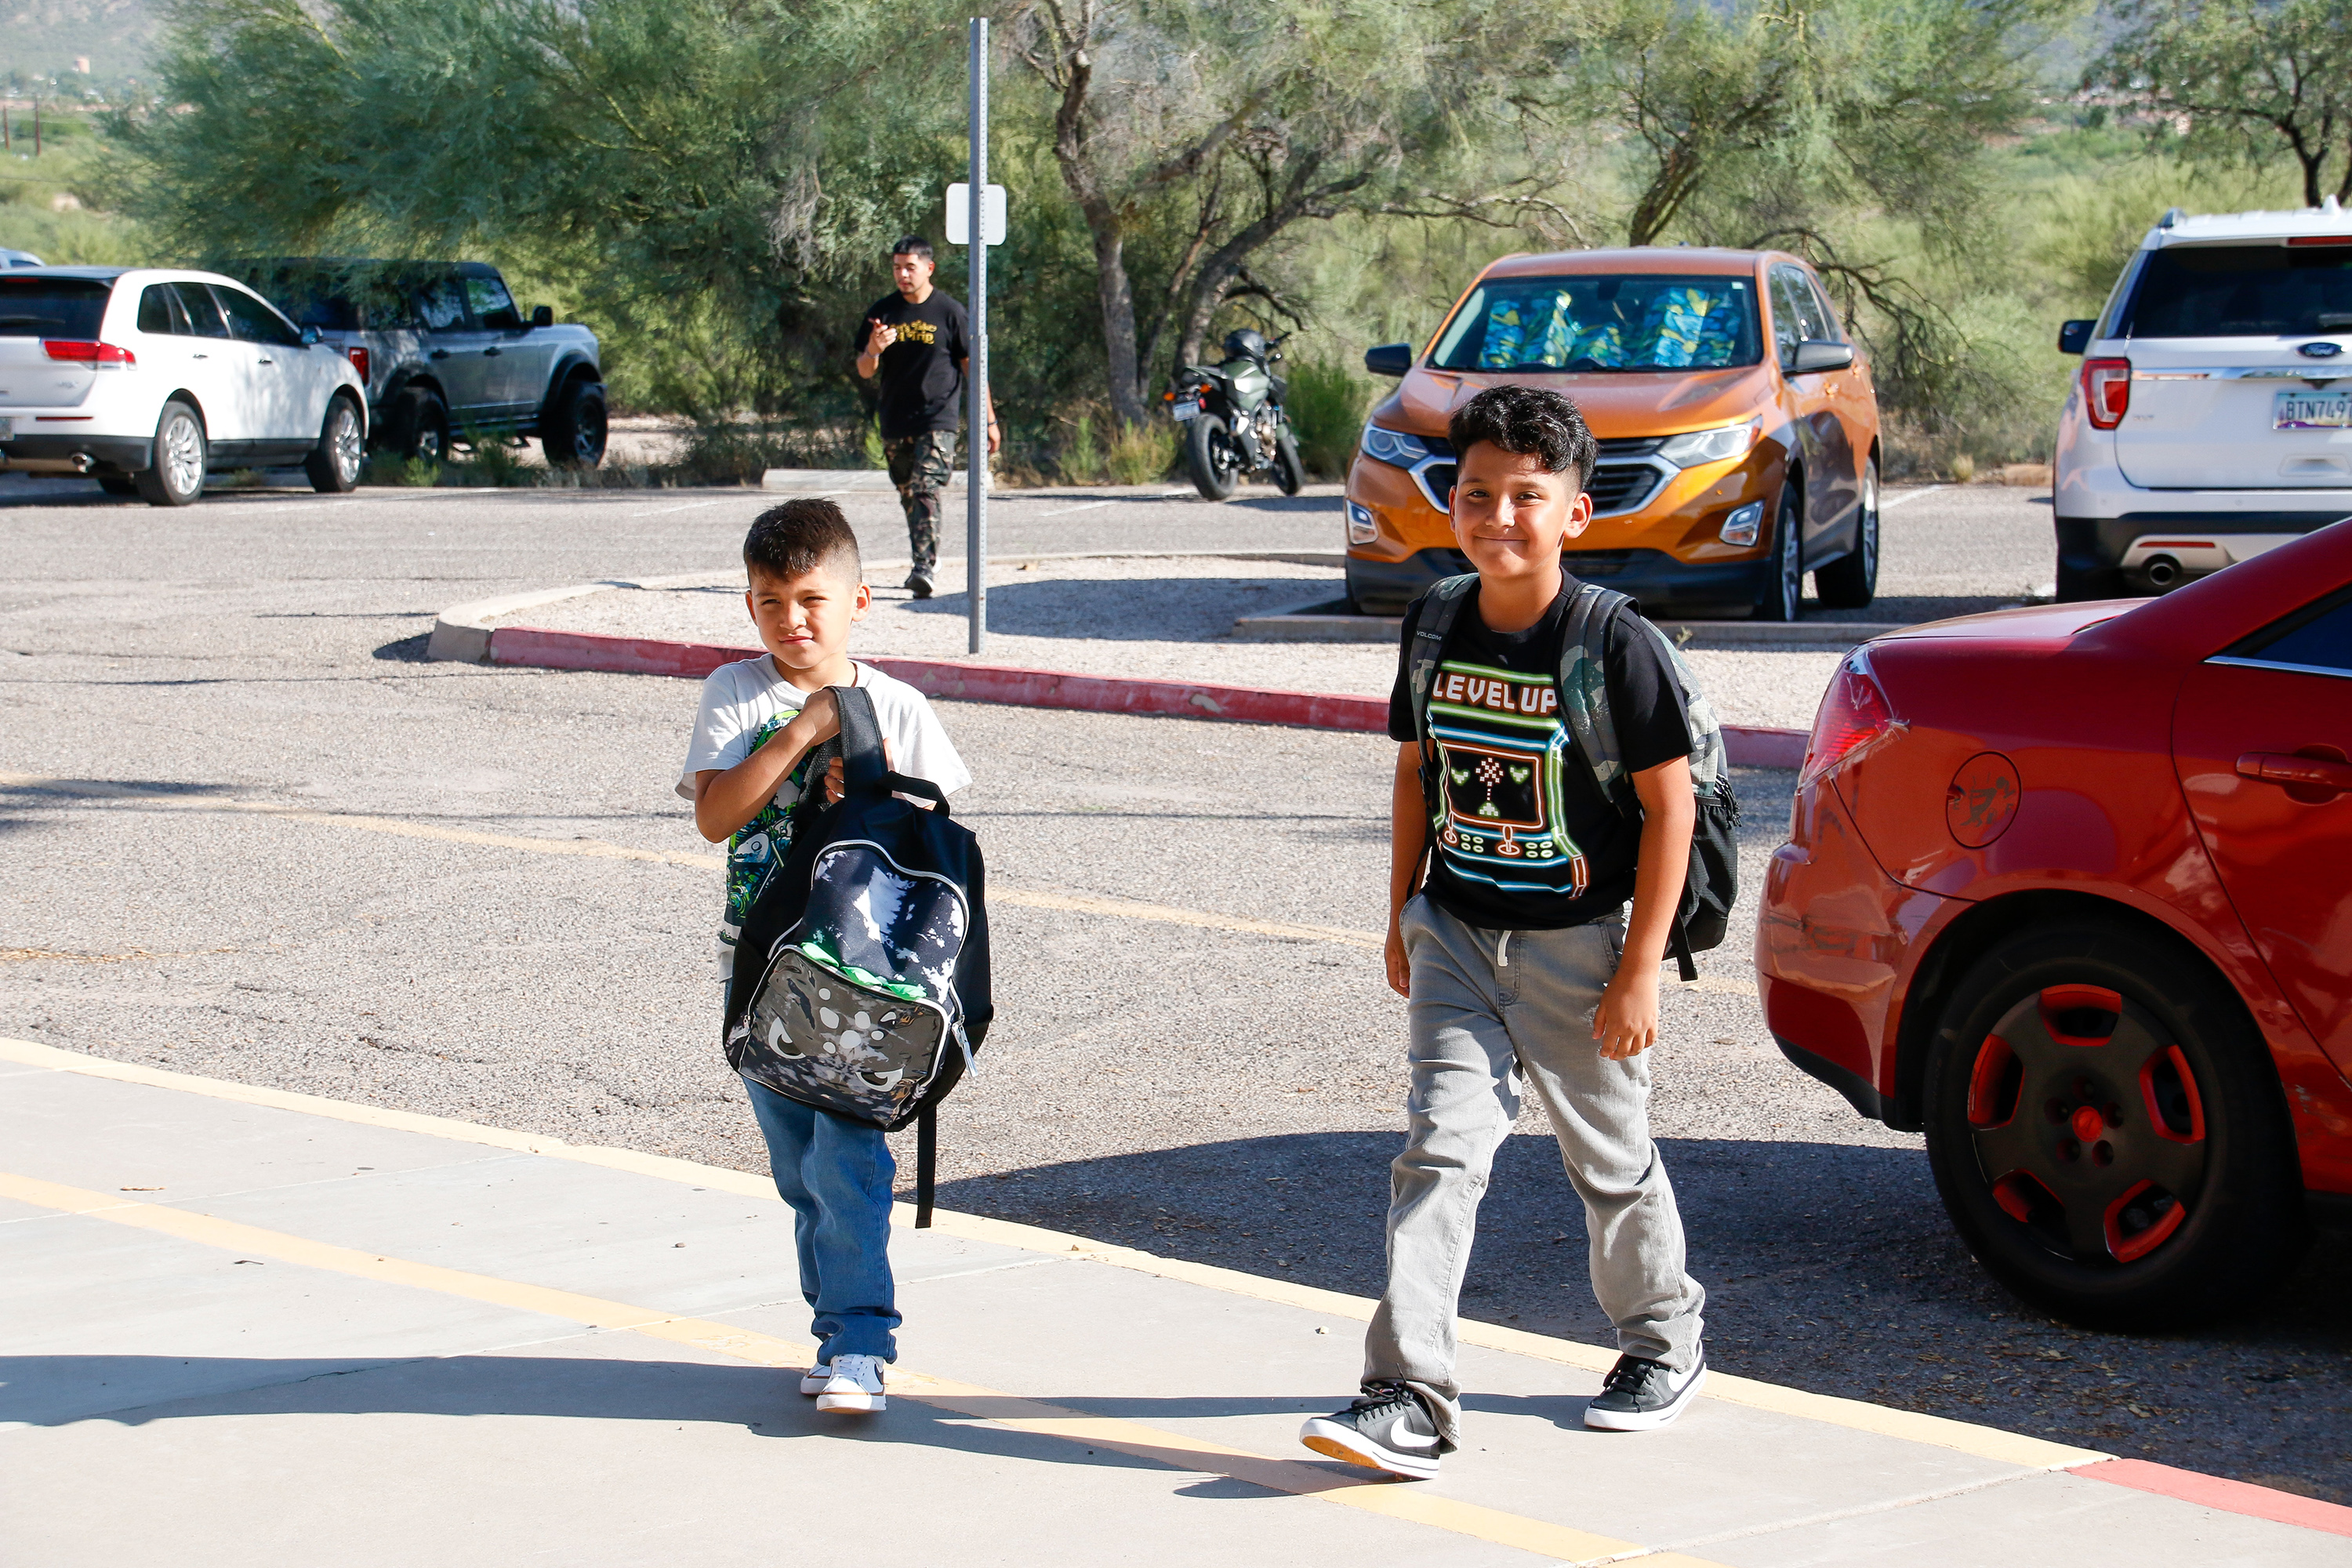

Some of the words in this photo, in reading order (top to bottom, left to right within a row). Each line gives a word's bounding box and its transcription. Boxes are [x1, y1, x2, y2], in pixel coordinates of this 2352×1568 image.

[906, 330, 935, 345] Trip
[1417, 630, 1443, 641] VOLCOM
[1432, 673, 1515, 710] LEVEL
[1520, 687, 1558, 713] UP
